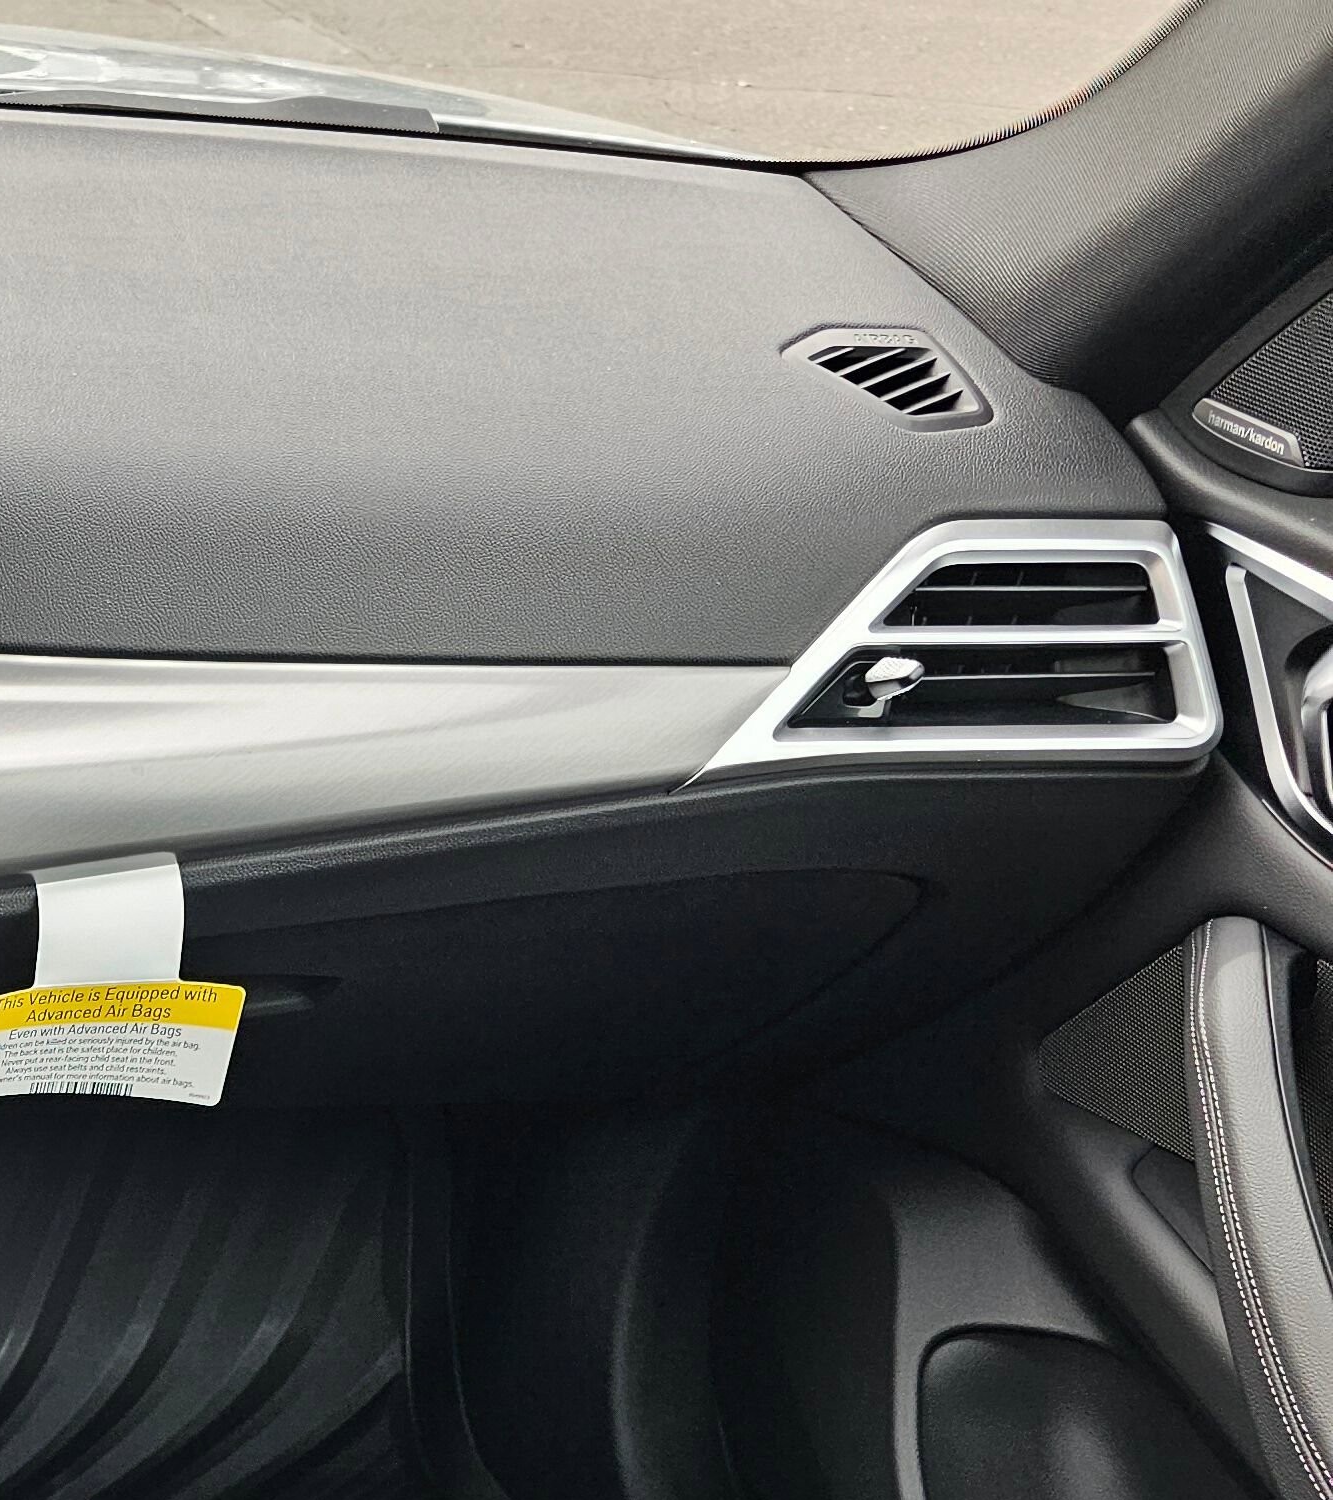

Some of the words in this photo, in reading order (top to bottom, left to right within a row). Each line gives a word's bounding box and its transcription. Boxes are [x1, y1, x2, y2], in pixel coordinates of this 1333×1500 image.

[1208, 410, 1285, 456] harman/kardon
[29, 990, 84, 1006] Vehicle
[88, 988, 100, 1002] is
[104, 986, 181, 1004] Equipped
[184, 987, 218, 1003] with
[25, 1004, 102, 1023] Advanced
[104, 1004, 129, 1019] Air
[131, 1003, 171, 1021] Bags
[9, 1029, 37, 1041] Even
[40, 1026, 65, 1037] with
[67, 1023, 127, 1037] Advanced
[129, 1023, 148, 1034] Air
[150, 1024, 182, 1038] Bags
[19, 1041, 33, 1049] can
[34, 1039, 44, 1047] be
[78, 1037, 114, 1045] seriously
[115, 1038, 144, 1047] injured
[144, 1038, 154, 1048] by
[156, 1038, 169, 1047] the
[4, 1050, 18, 1059] The
